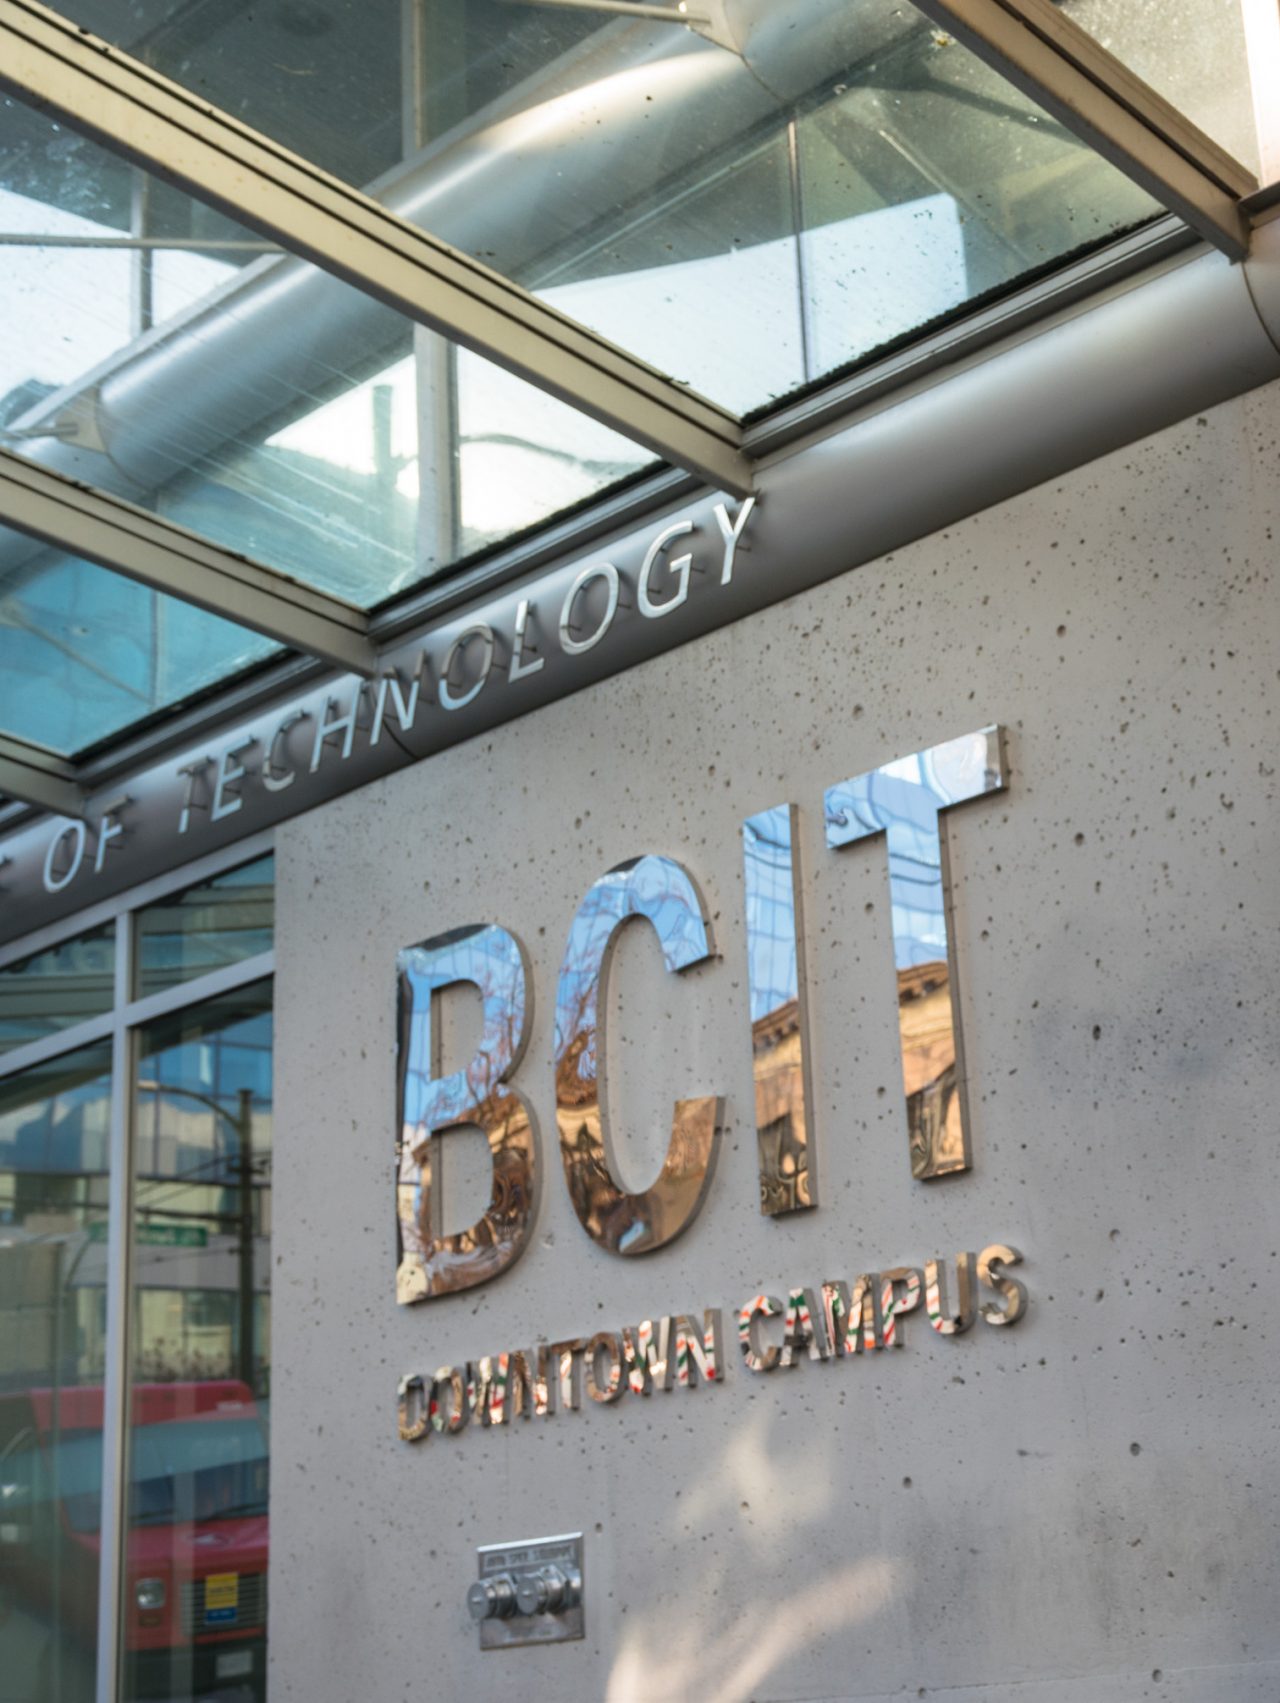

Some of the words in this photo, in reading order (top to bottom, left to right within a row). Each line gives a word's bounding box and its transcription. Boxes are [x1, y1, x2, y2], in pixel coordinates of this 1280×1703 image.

[43, 796, 129, 893] OF
[176, 496, 756, 834] TECHNOLOGY
[395, 723, 1010, 1305] BCIT
[396, 1308, 725, 1441] DOWNTOWN
[736, 1243, 1028, 1372] CAMPUS
